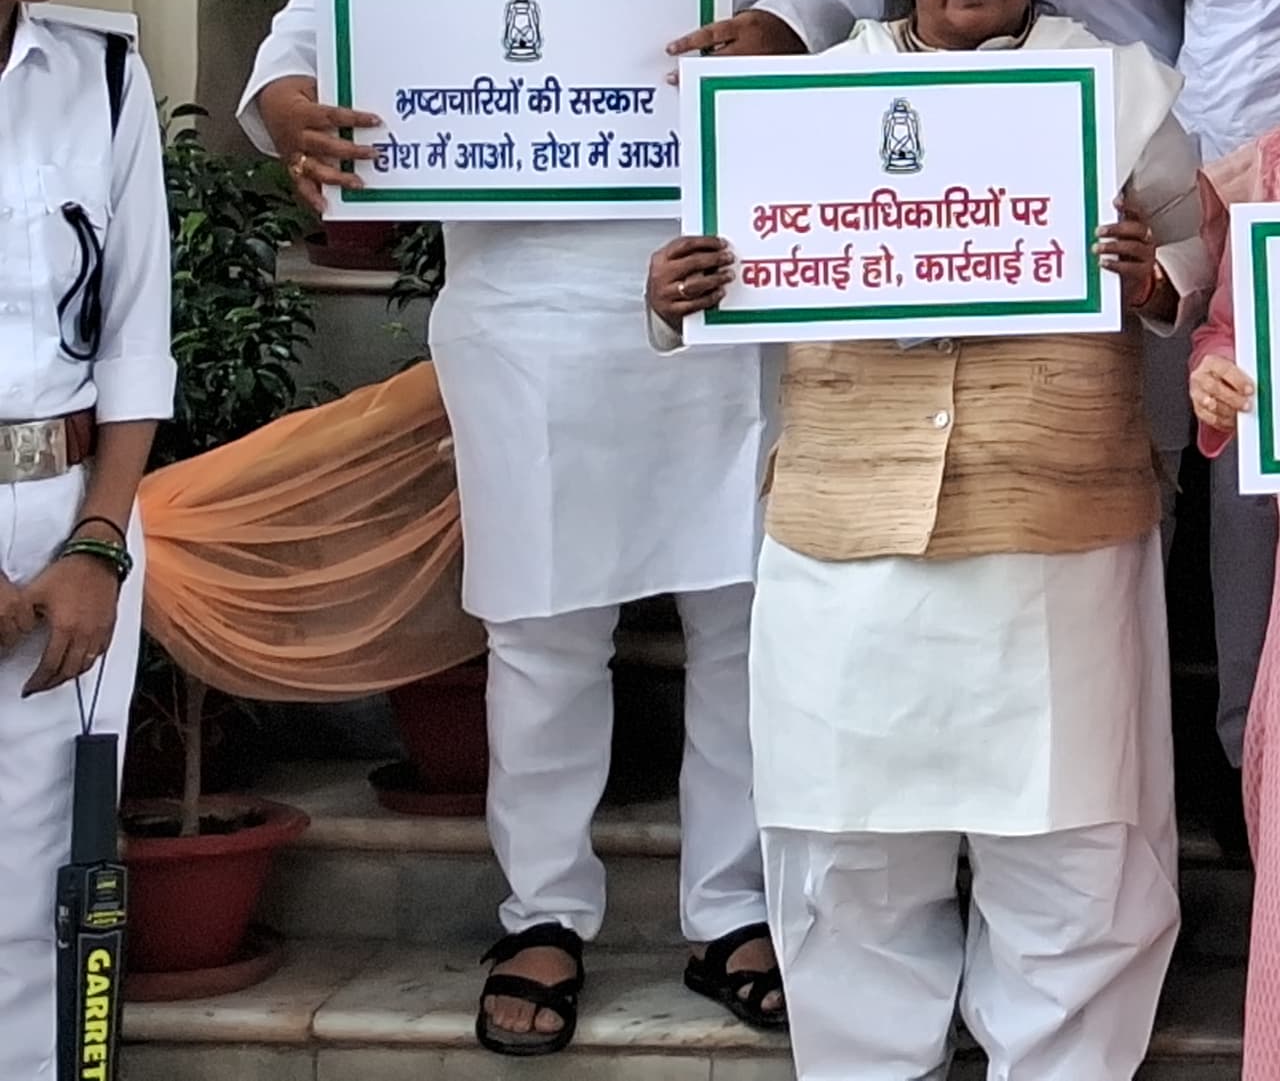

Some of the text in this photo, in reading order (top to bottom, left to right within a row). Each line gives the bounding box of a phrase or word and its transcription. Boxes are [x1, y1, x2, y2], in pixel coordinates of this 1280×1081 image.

[396, 76, 656, 120] भ्रष्टाचारियों की सरकार
[373, 131, 679, 173] होश में आओ, होश में आओ
[754, 187, 1050, 239] भ्रष्ट पदाधिकारियों पर
[740, 239, 1064, 290] कार्रवाई हो, कार्रवाई हो
